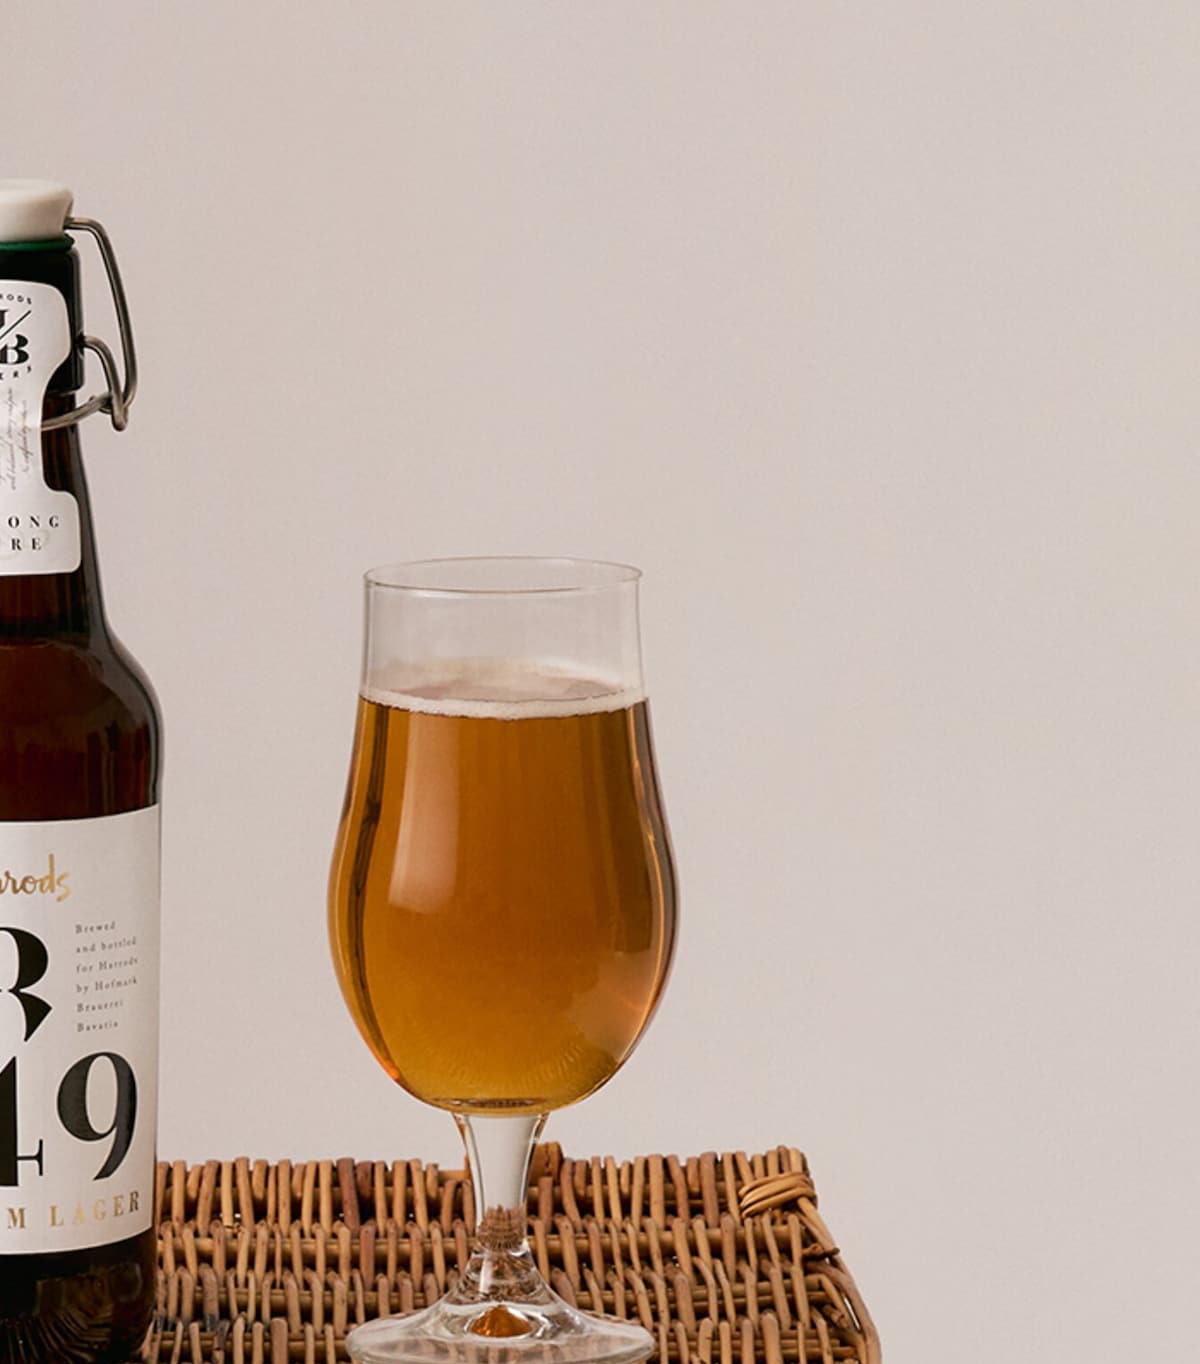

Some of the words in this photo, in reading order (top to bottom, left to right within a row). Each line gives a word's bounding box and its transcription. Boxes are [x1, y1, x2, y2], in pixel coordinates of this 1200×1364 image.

[75, 921, 116, 934] Brewed
[76, 943, 96, 953] and
[101, 936, 136, 951] bottled
[76, 963, 93, 973] for
[99, 956, 138, 971] Harrods
[76, 983, 89, 995] by
[49, 1190, 140, 1227] LAGER
